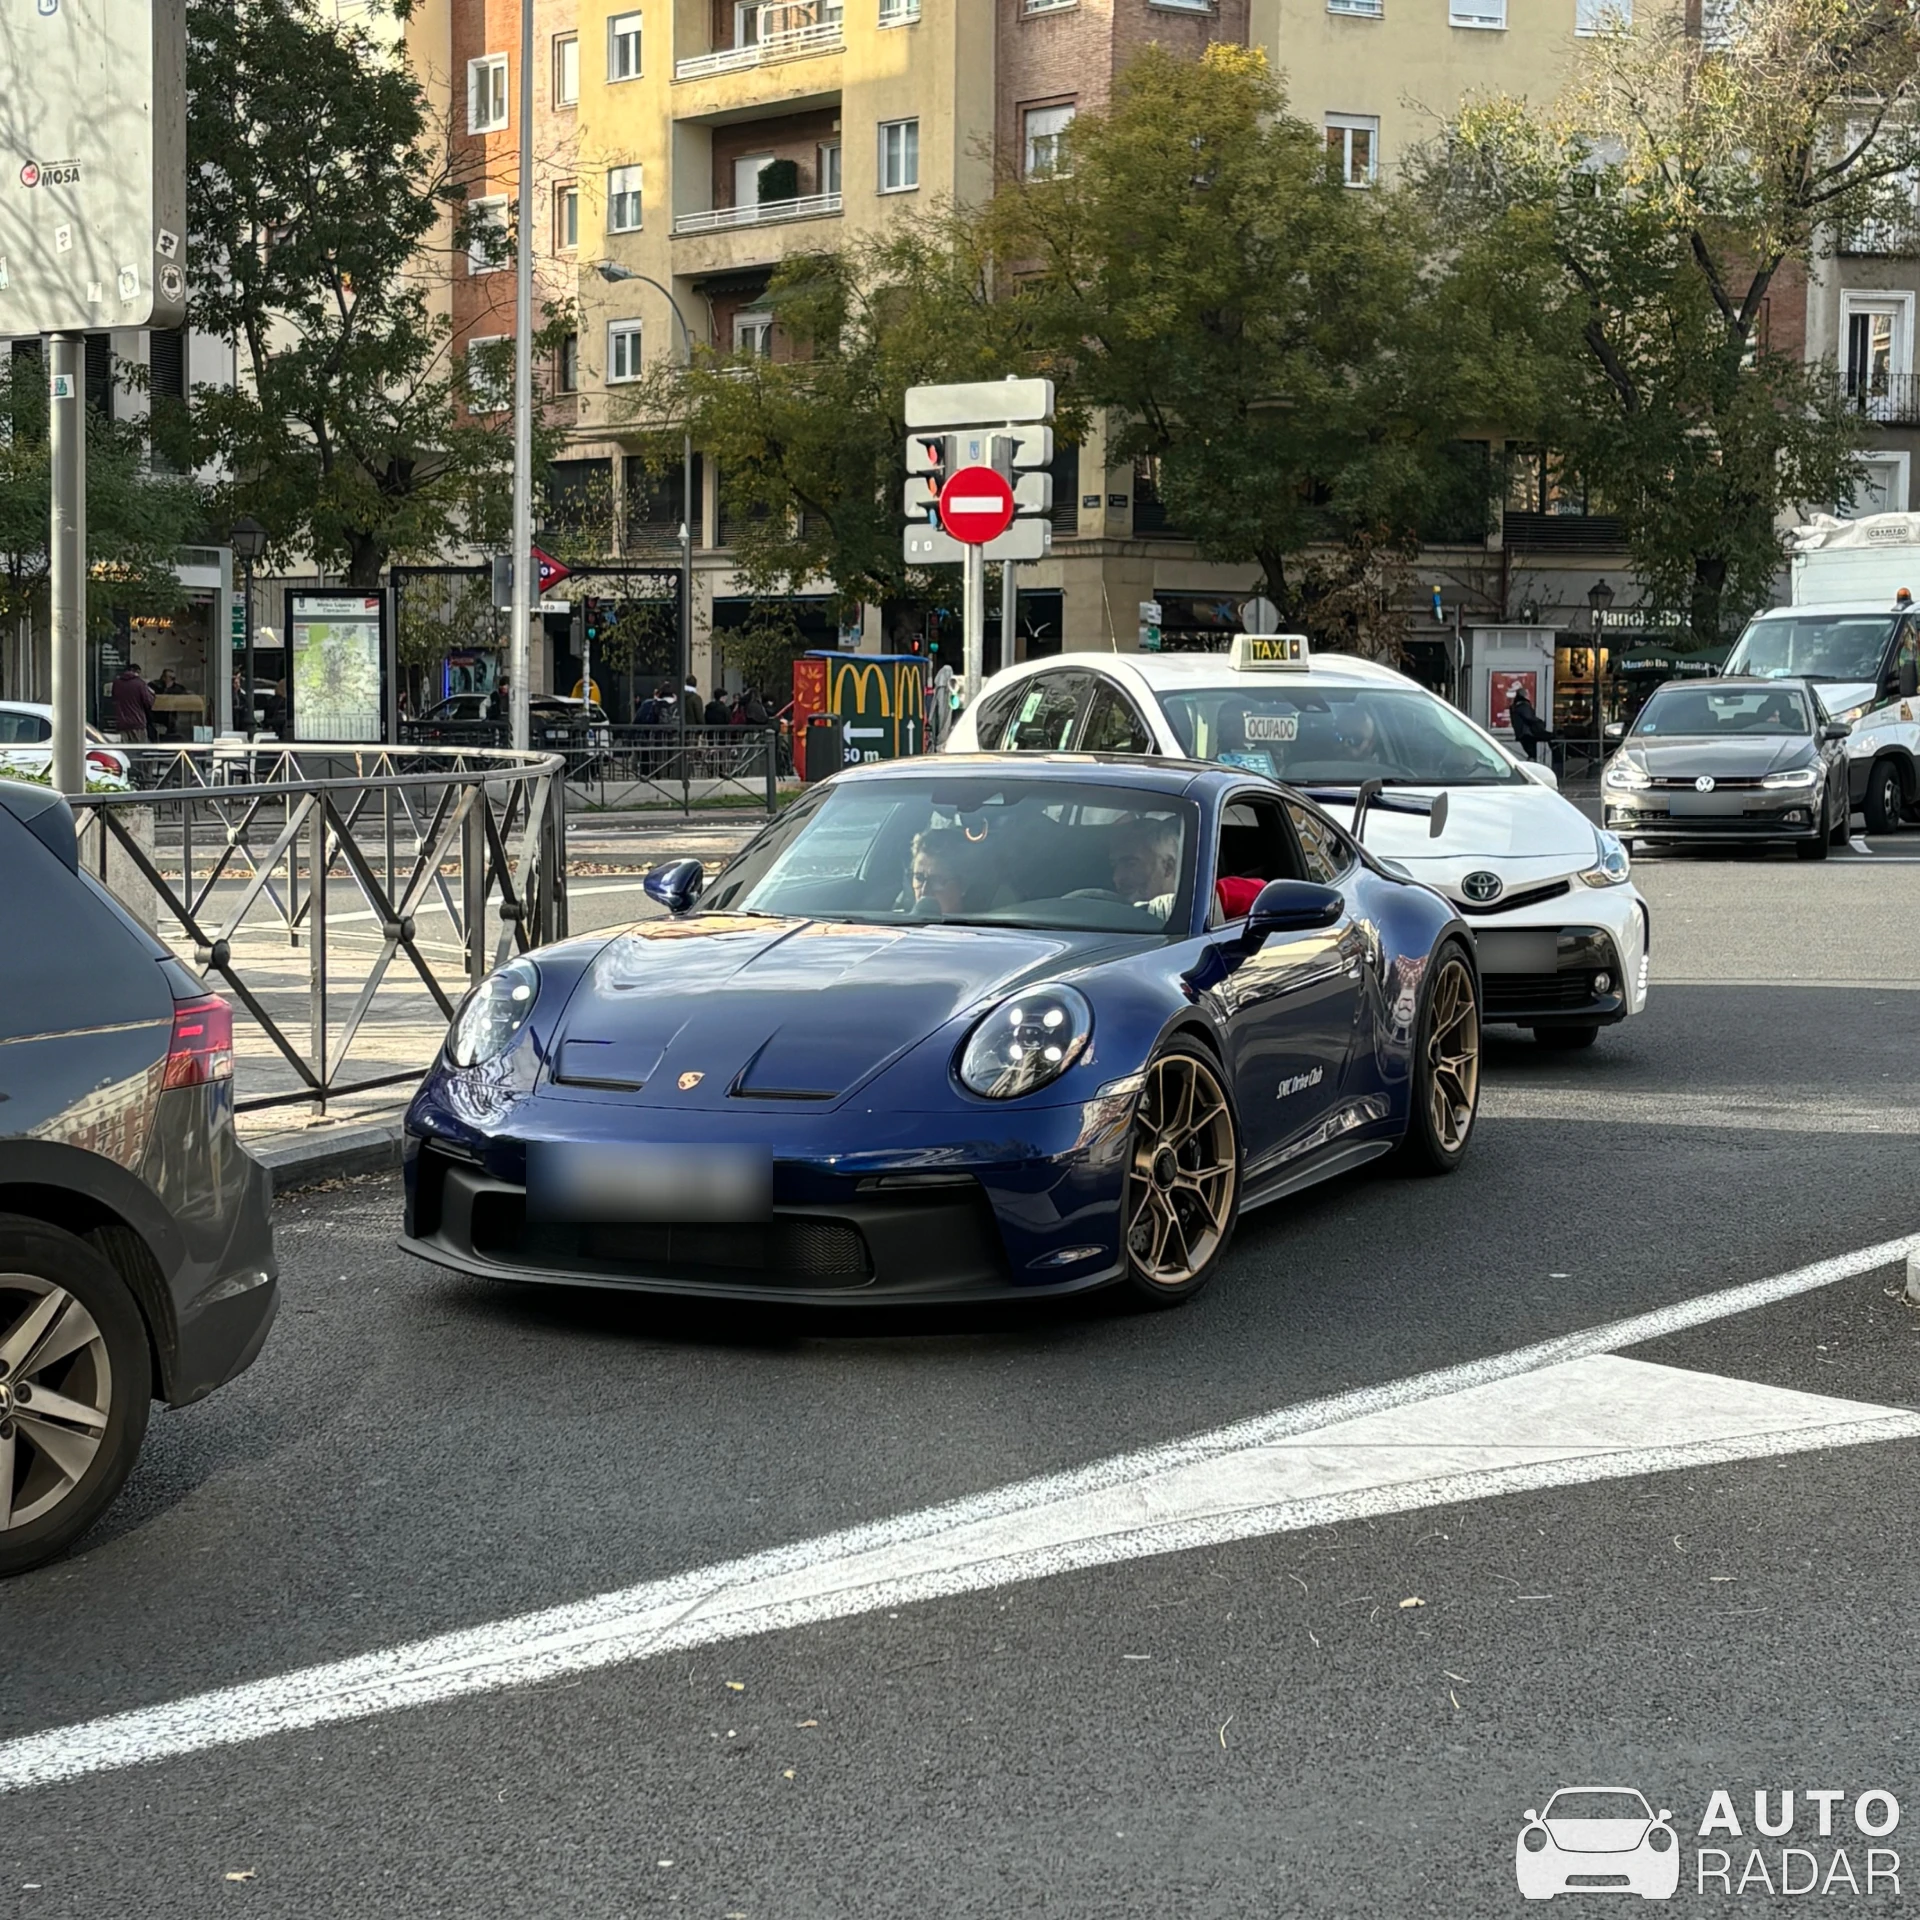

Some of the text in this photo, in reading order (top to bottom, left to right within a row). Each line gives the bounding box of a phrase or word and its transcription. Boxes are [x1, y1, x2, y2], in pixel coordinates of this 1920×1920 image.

[42, 168, 80, 186] MOSA
[1591, 609, 1655, 627] Manol
[1253, 641, 1287, 659] TAXI
[1248, 719, 1295, 738] OCUPADO
